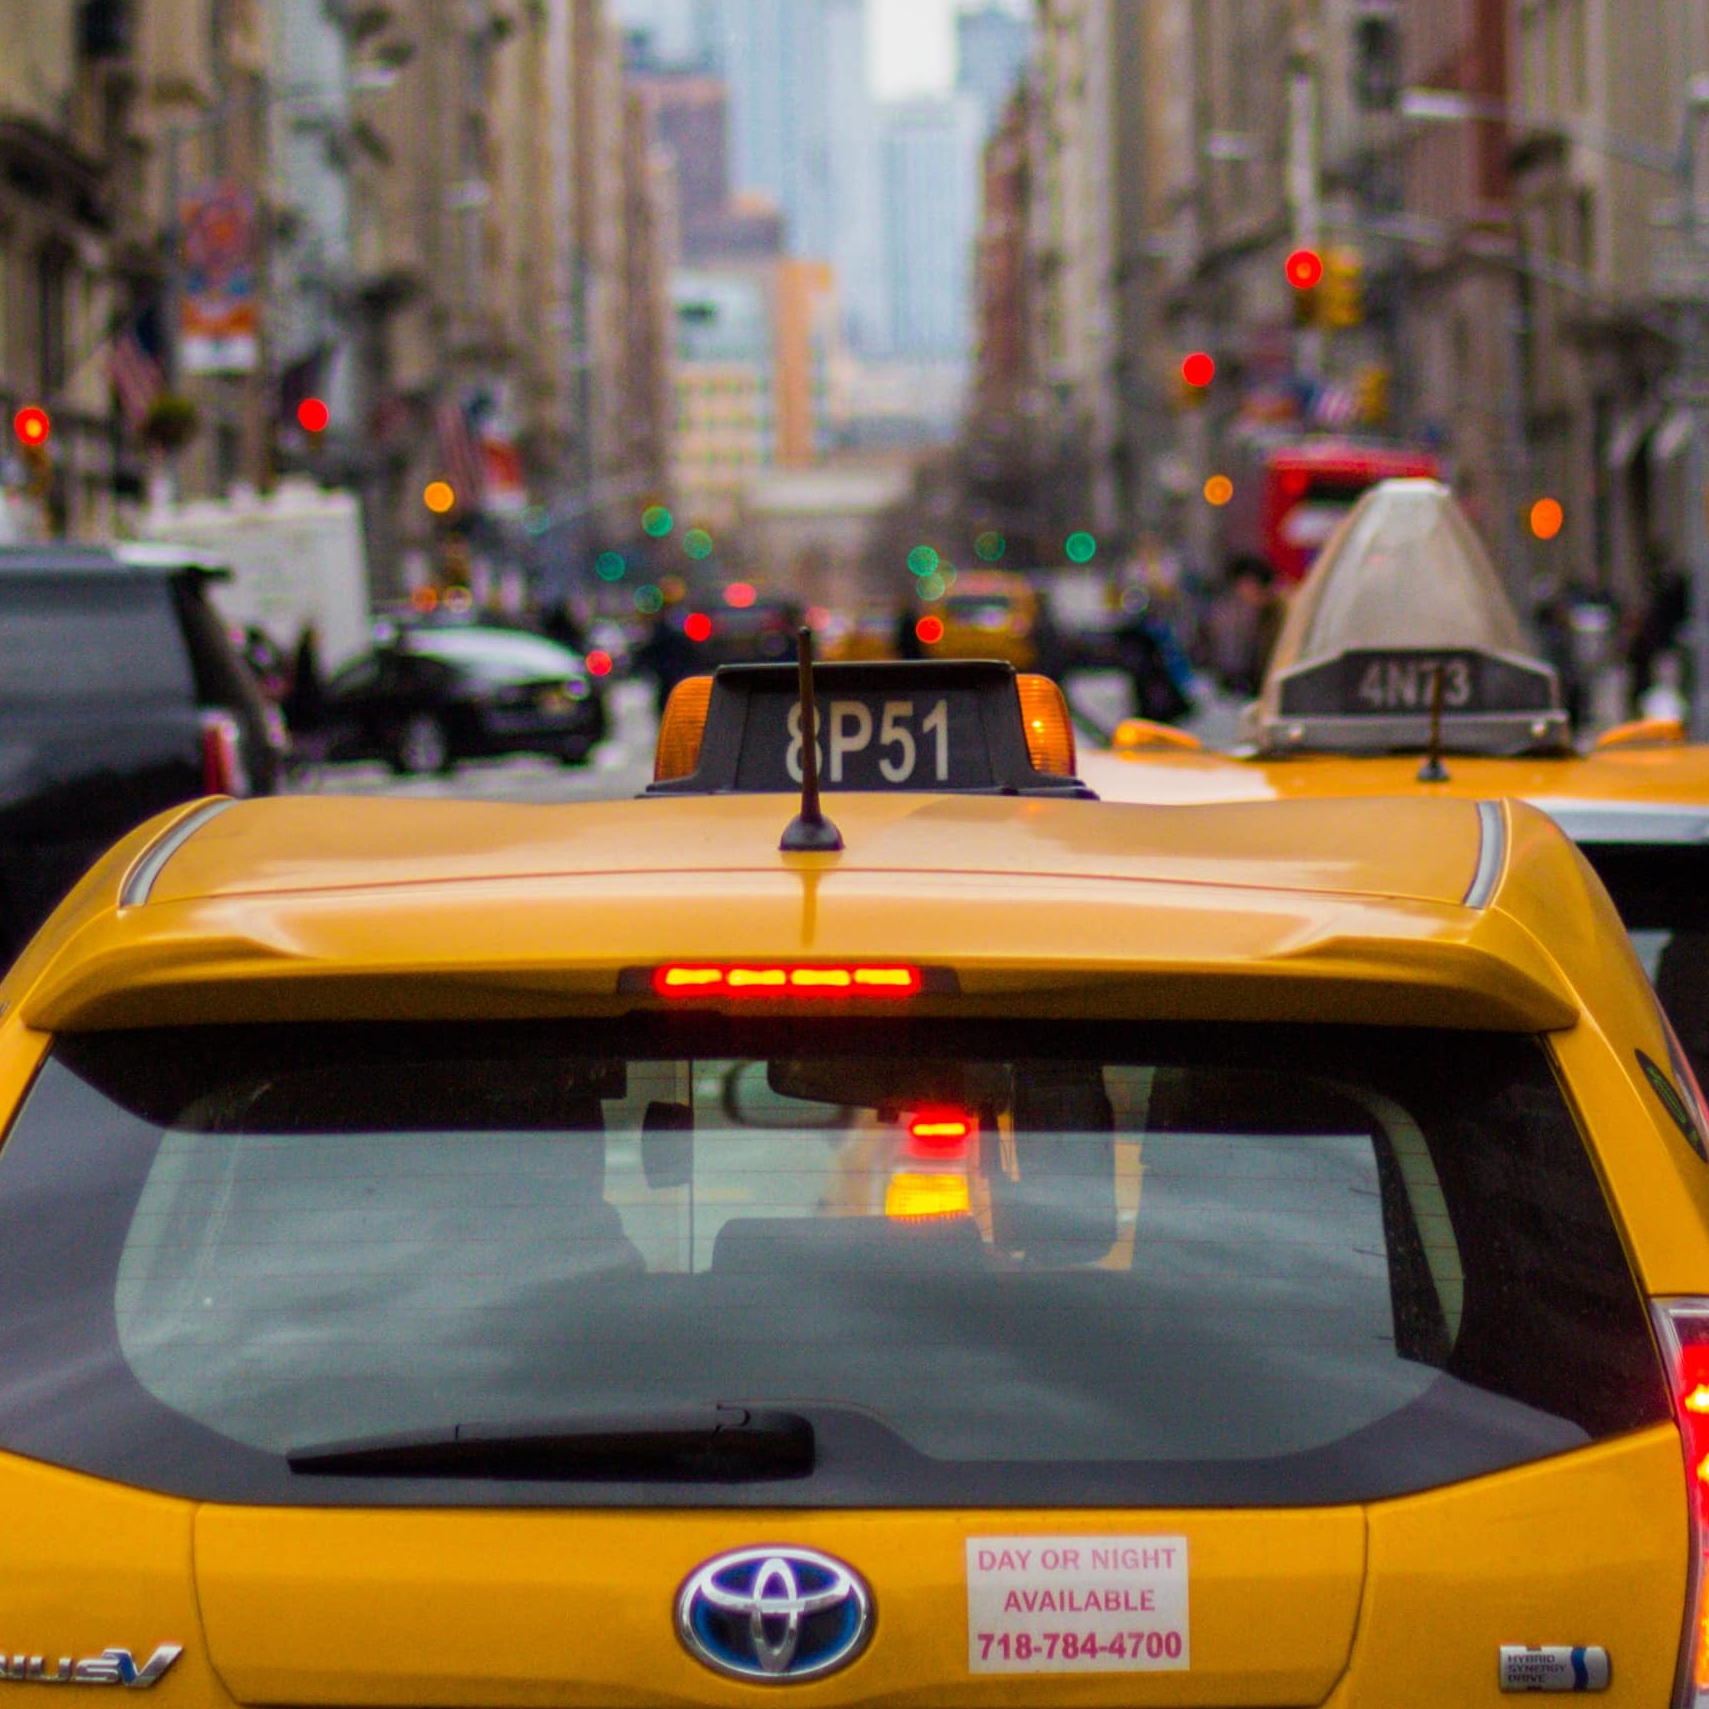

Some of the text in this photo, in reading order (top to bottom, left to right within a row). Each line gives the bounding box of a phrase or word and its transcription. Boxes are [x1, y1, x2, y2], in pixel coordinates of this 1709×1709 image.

[1360, 663, 1471, 707] 4N73
[785, 700, 951, 784] 8P51
[979, 1548, 1177, 1571] DAY OR NIGHT
[1003, 1589, 1156, 1614] AVAILABLE
[977, 1631, 1183, 1662] 718-784-4700
[1507, 1654, 1556, 1663] HYBRID
